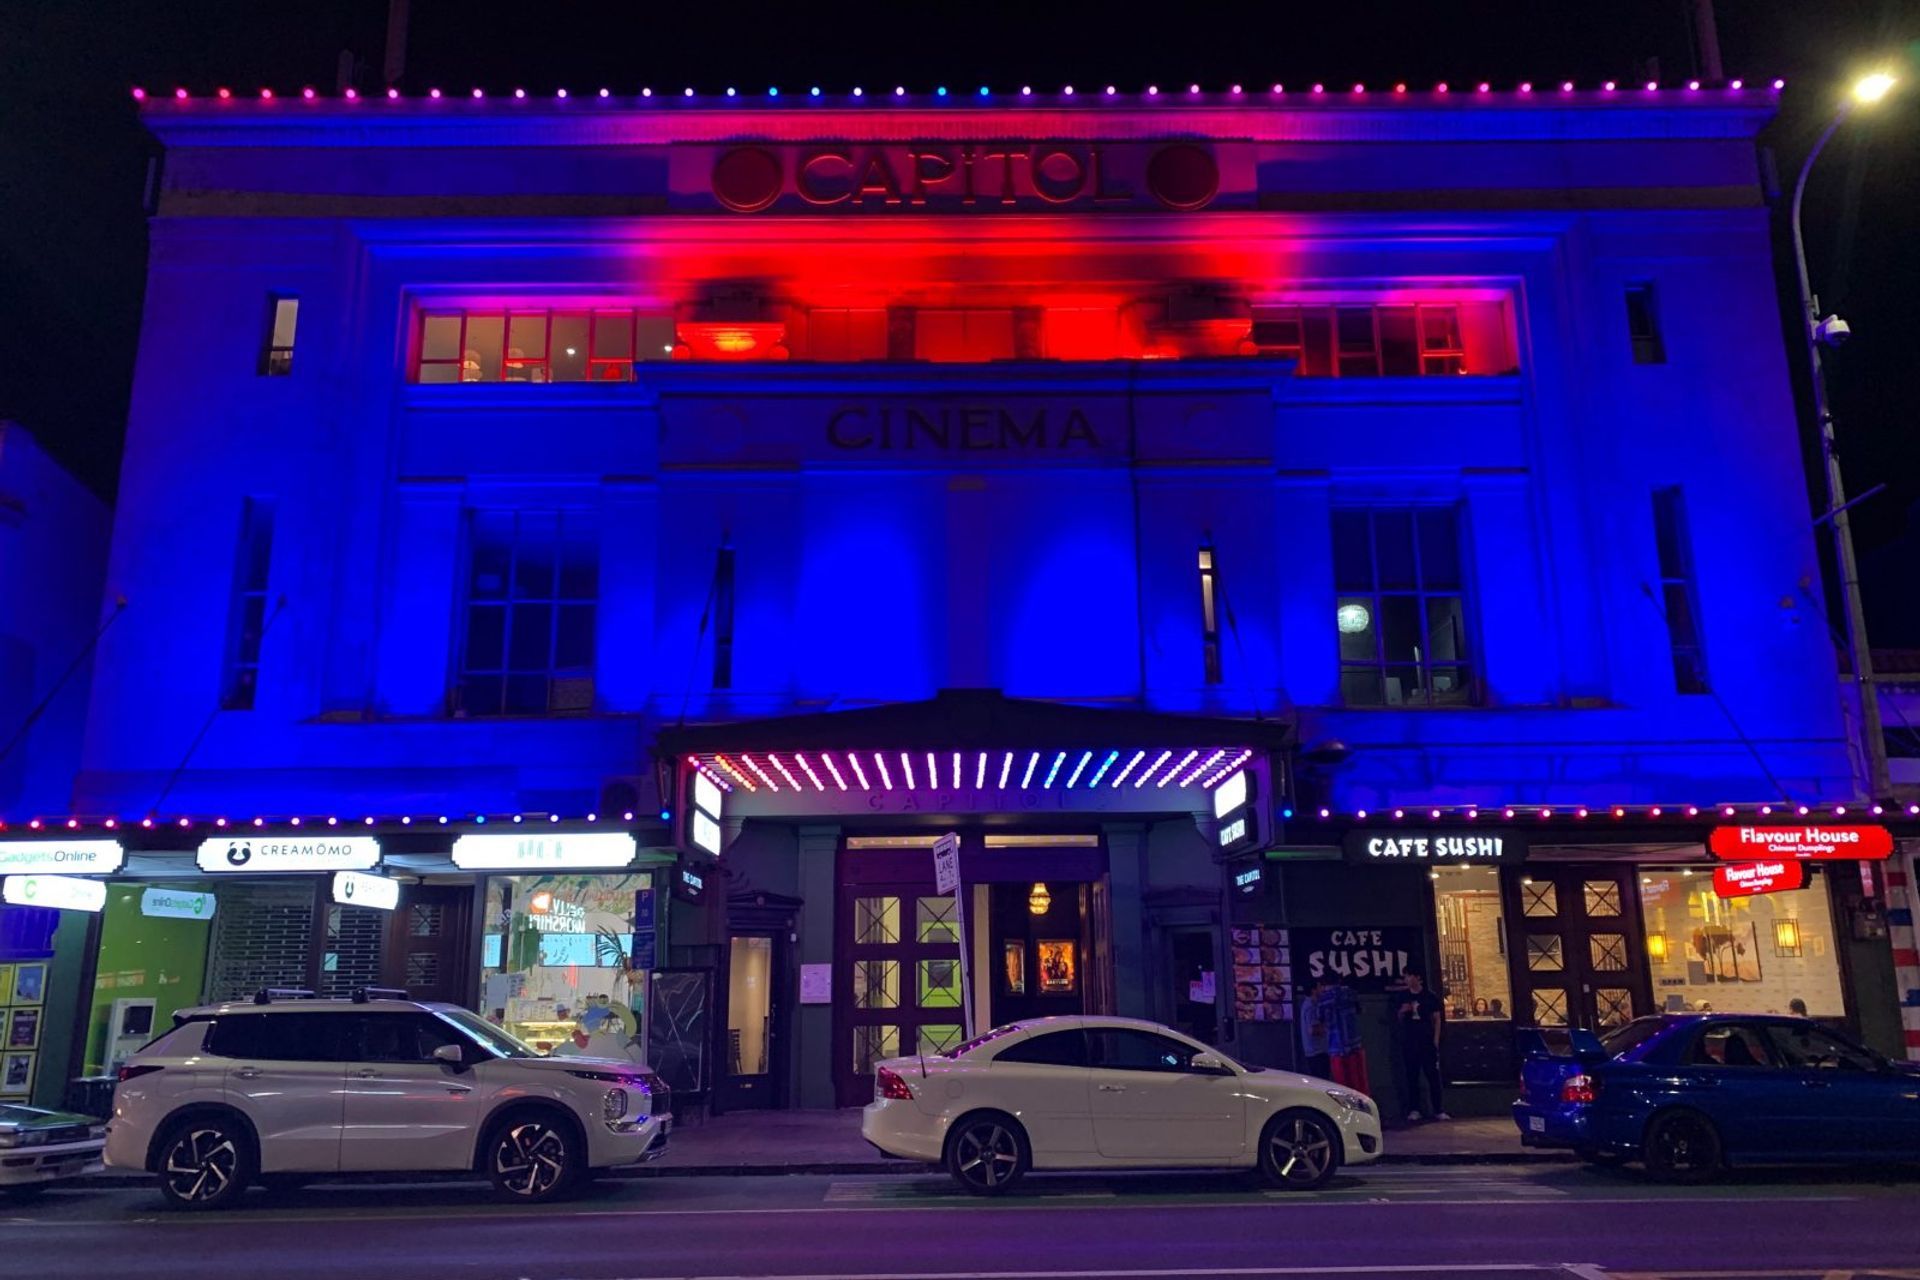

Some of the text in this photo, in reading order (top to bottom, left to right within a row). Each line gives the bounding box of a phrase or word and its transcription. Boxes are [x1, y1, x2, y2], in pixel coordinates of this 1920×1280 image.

[826, 407, 1102, 450] CINEMA
[1740, 828, 1859, 844] Flavour House
[1368, 837, 1503, 857] CAFE SUSHI
[1756, 863, 1785, 877] House
[1331, 930, 1383, 946] CAFE
[1309, 950, 1408, 978] SUSHI
